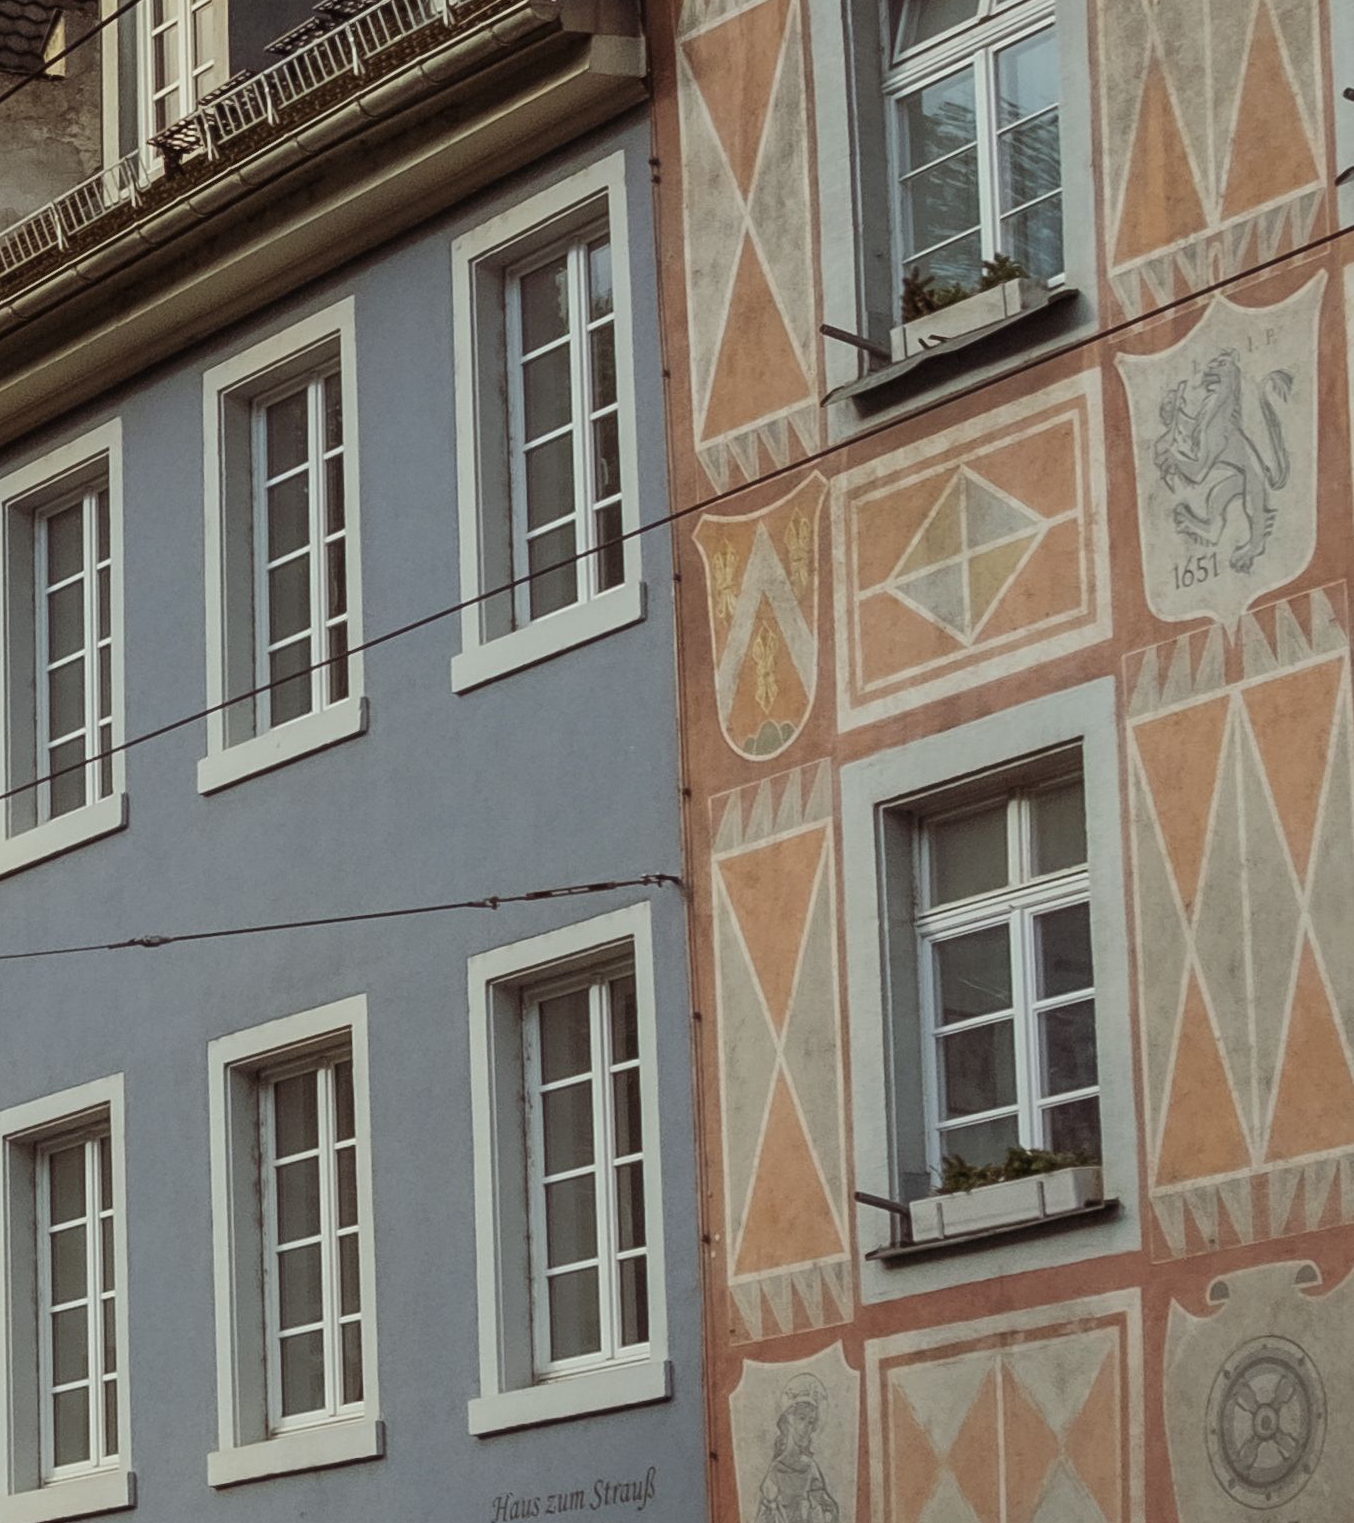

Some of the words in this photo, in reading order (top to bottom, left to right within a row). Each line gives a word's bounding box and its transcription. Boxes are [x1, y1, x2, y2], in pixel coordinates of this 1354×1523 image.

[1171, 551, 1221, 590] 1651
[491, 1491, 541, 1523] Haus
[545, 1490, 585, 1515] zum
[589, 1466, 657, 1512] Strauß
